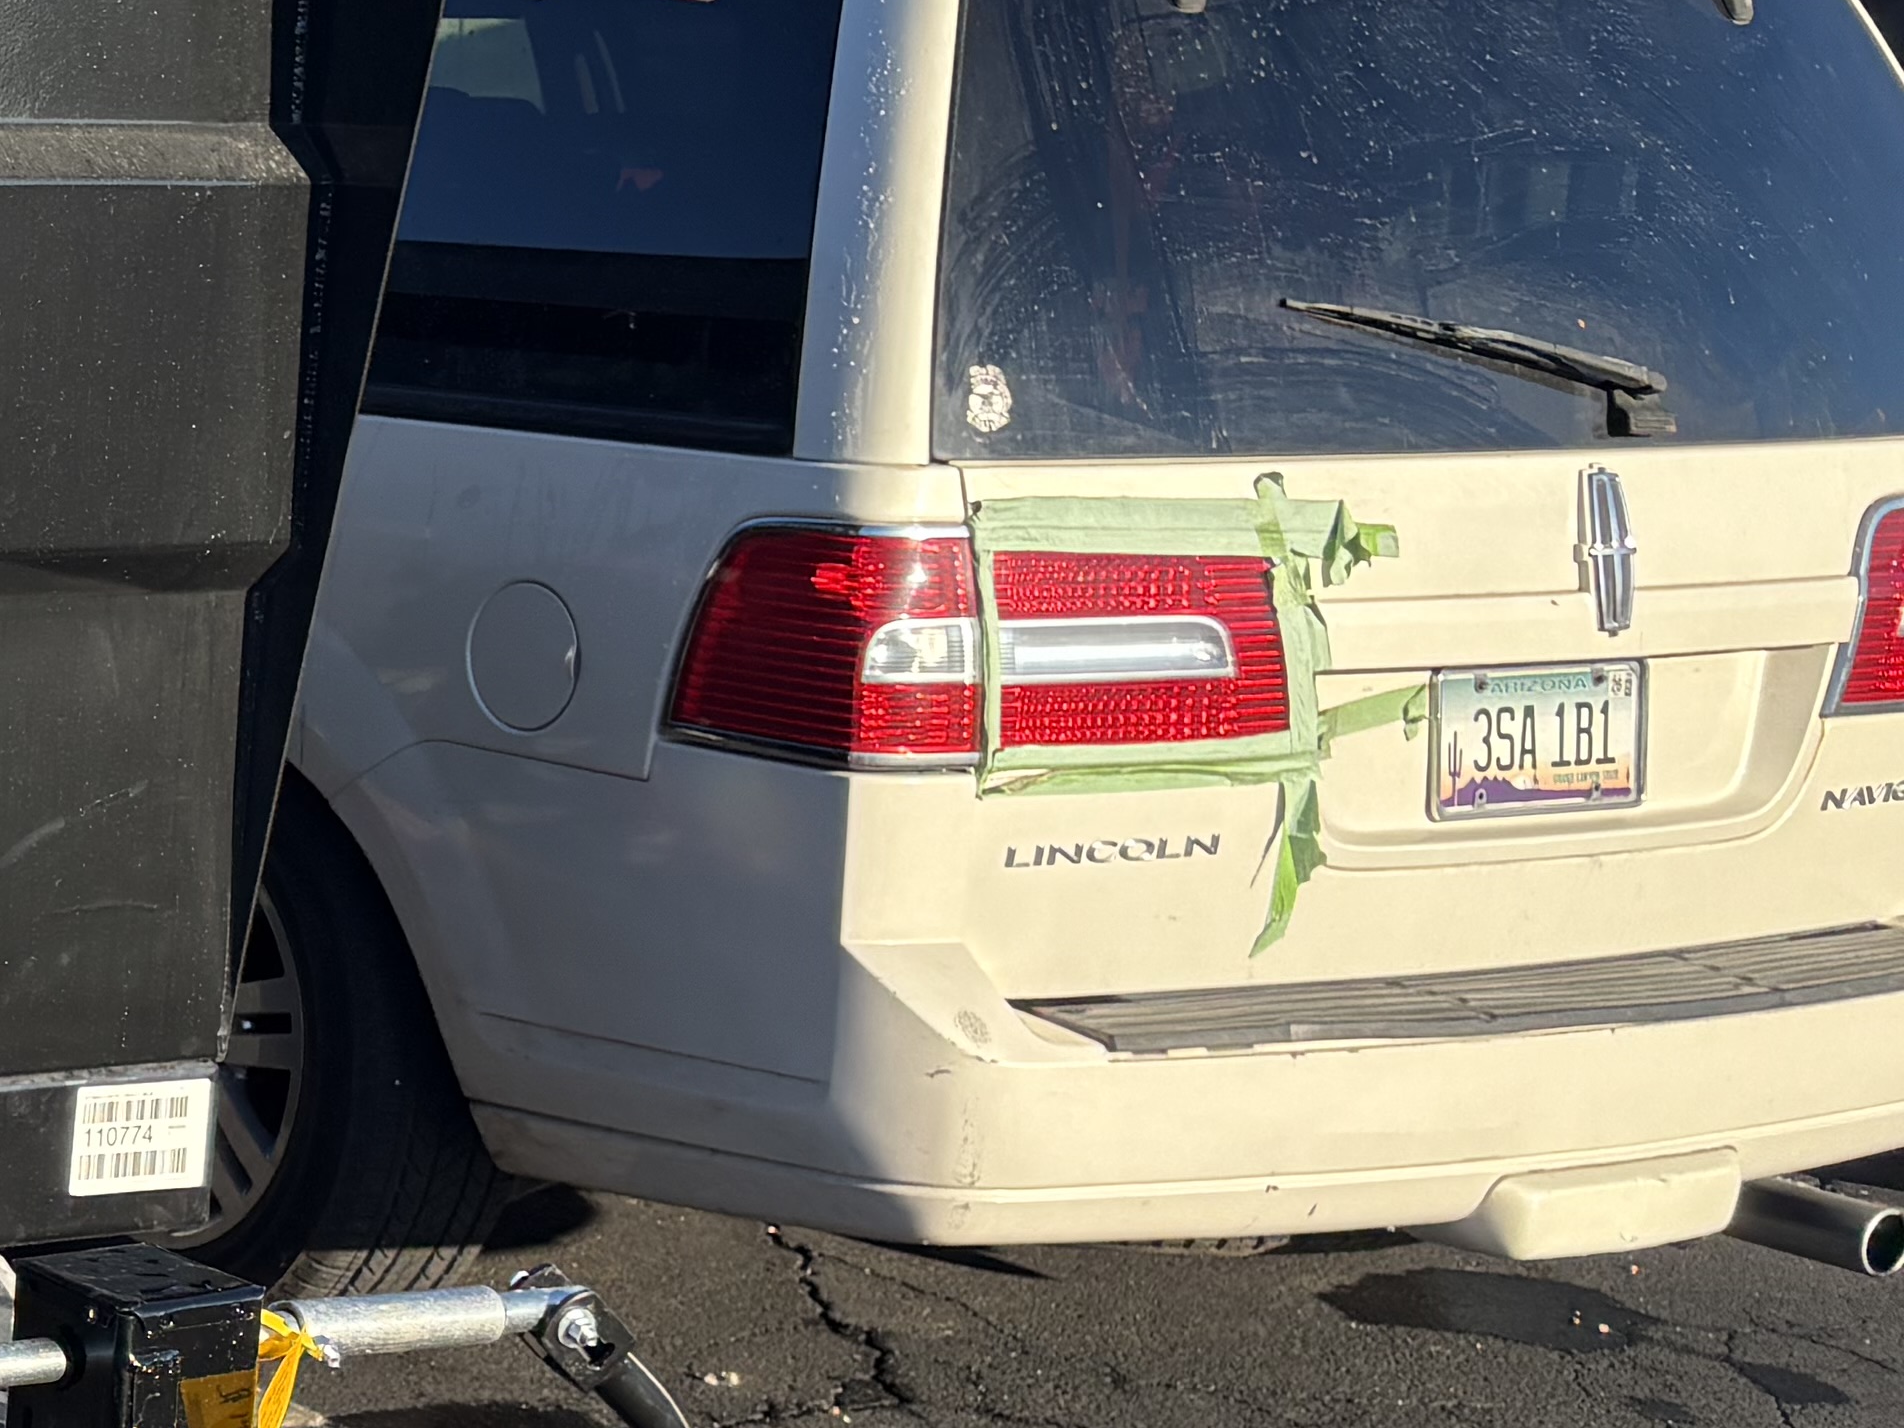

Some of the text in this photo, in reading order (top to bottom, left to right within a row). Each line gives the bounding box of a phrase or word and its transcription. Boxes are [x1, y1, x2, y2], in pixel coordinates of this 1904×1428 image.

[1490, 675, 1588, 694] ARIZONA
[1473, 699, 1616, 772] 3SA 1B1
[1004, 833, 1221, 868] LINCOLN
[85, 1124, 153, 1148] 110774
